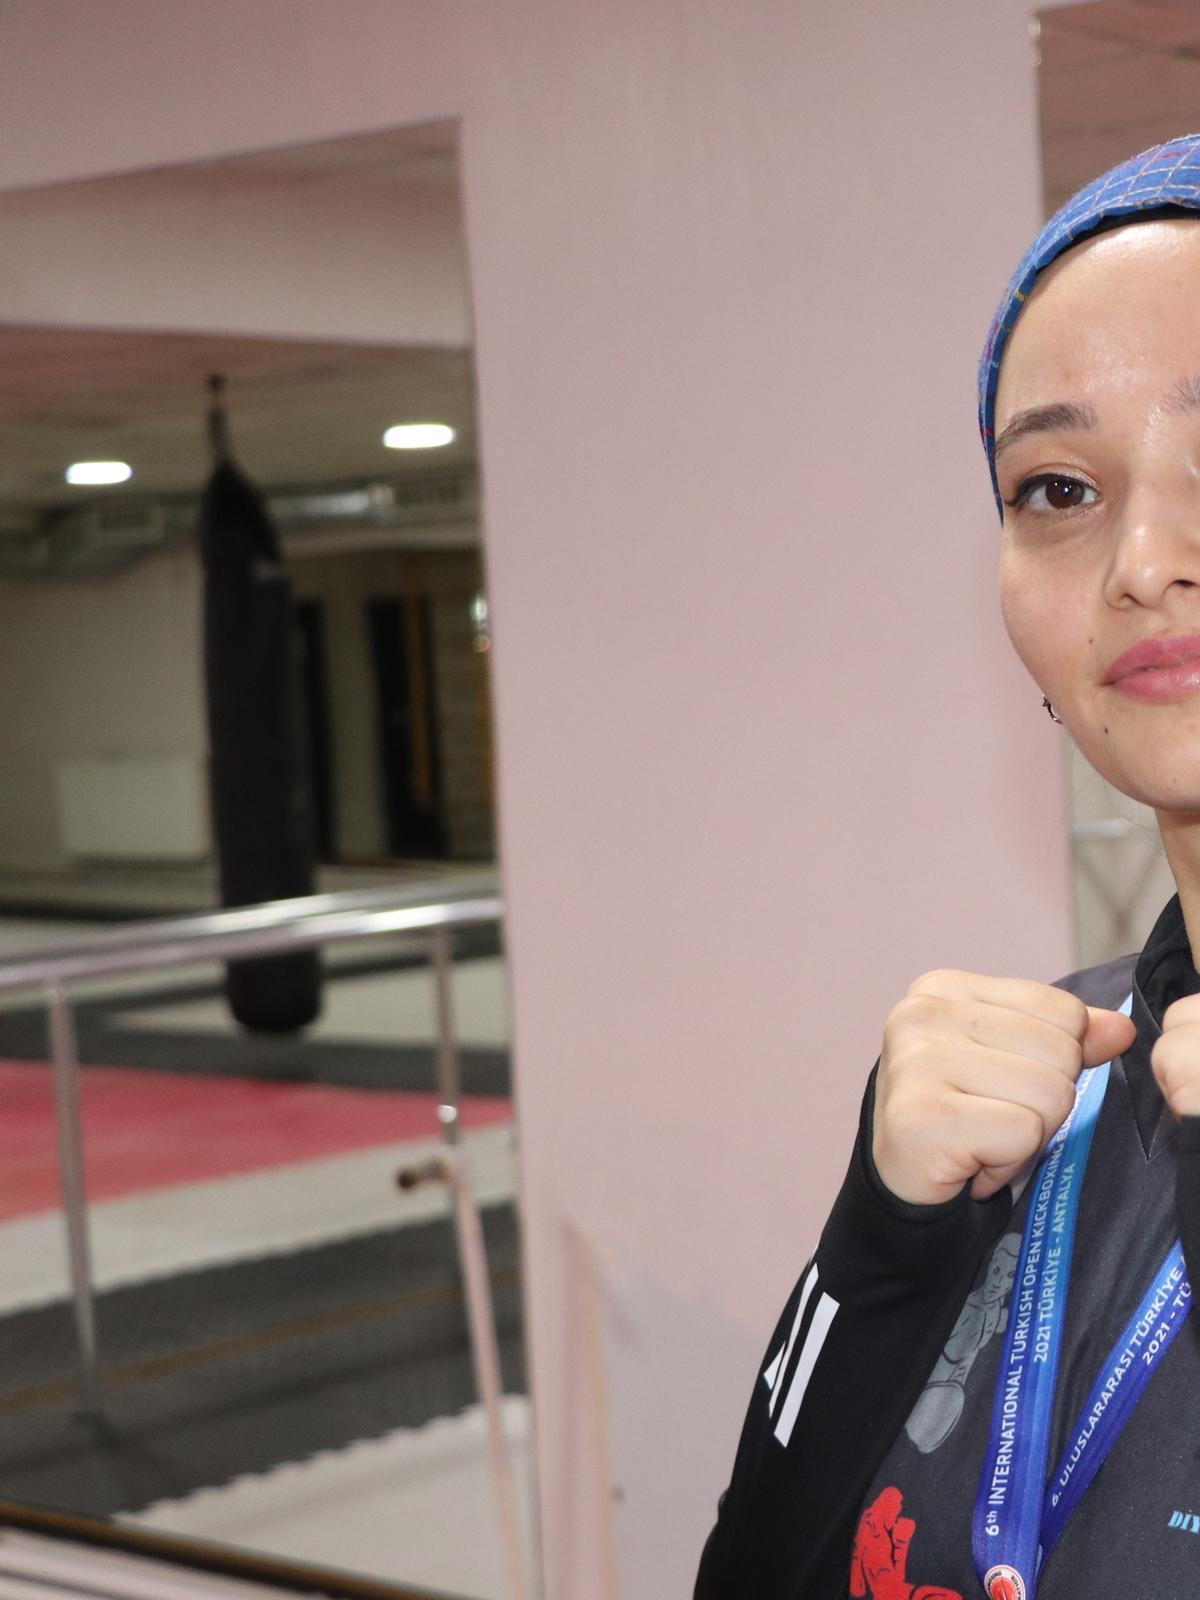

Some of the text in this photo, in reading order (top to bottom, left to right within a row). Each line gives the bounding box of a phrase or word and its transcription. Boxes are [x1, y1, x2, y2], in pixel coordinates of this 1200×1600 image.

[1052, 1162, 1075, 1234] ANTALYA
[1022, 1243, 1042, 1286] OPEN
[1037, 1248, 1061, 1321] TÜRKİYE
[1010, 1291, 1034, 1363] TURKISH
[1034, 1326, 1051, 1363] 2021
[1142, 1321, 1170, 1365] 2021
[1060, 1348, 1135, 1486] ULUSLARARASI
[1130, 1267, 1182, 1346] TÜRKİYE
[988, 1365, 1022, 1504] INTERNATIONAL
[985, 1510, 1000, 1536] 6th
